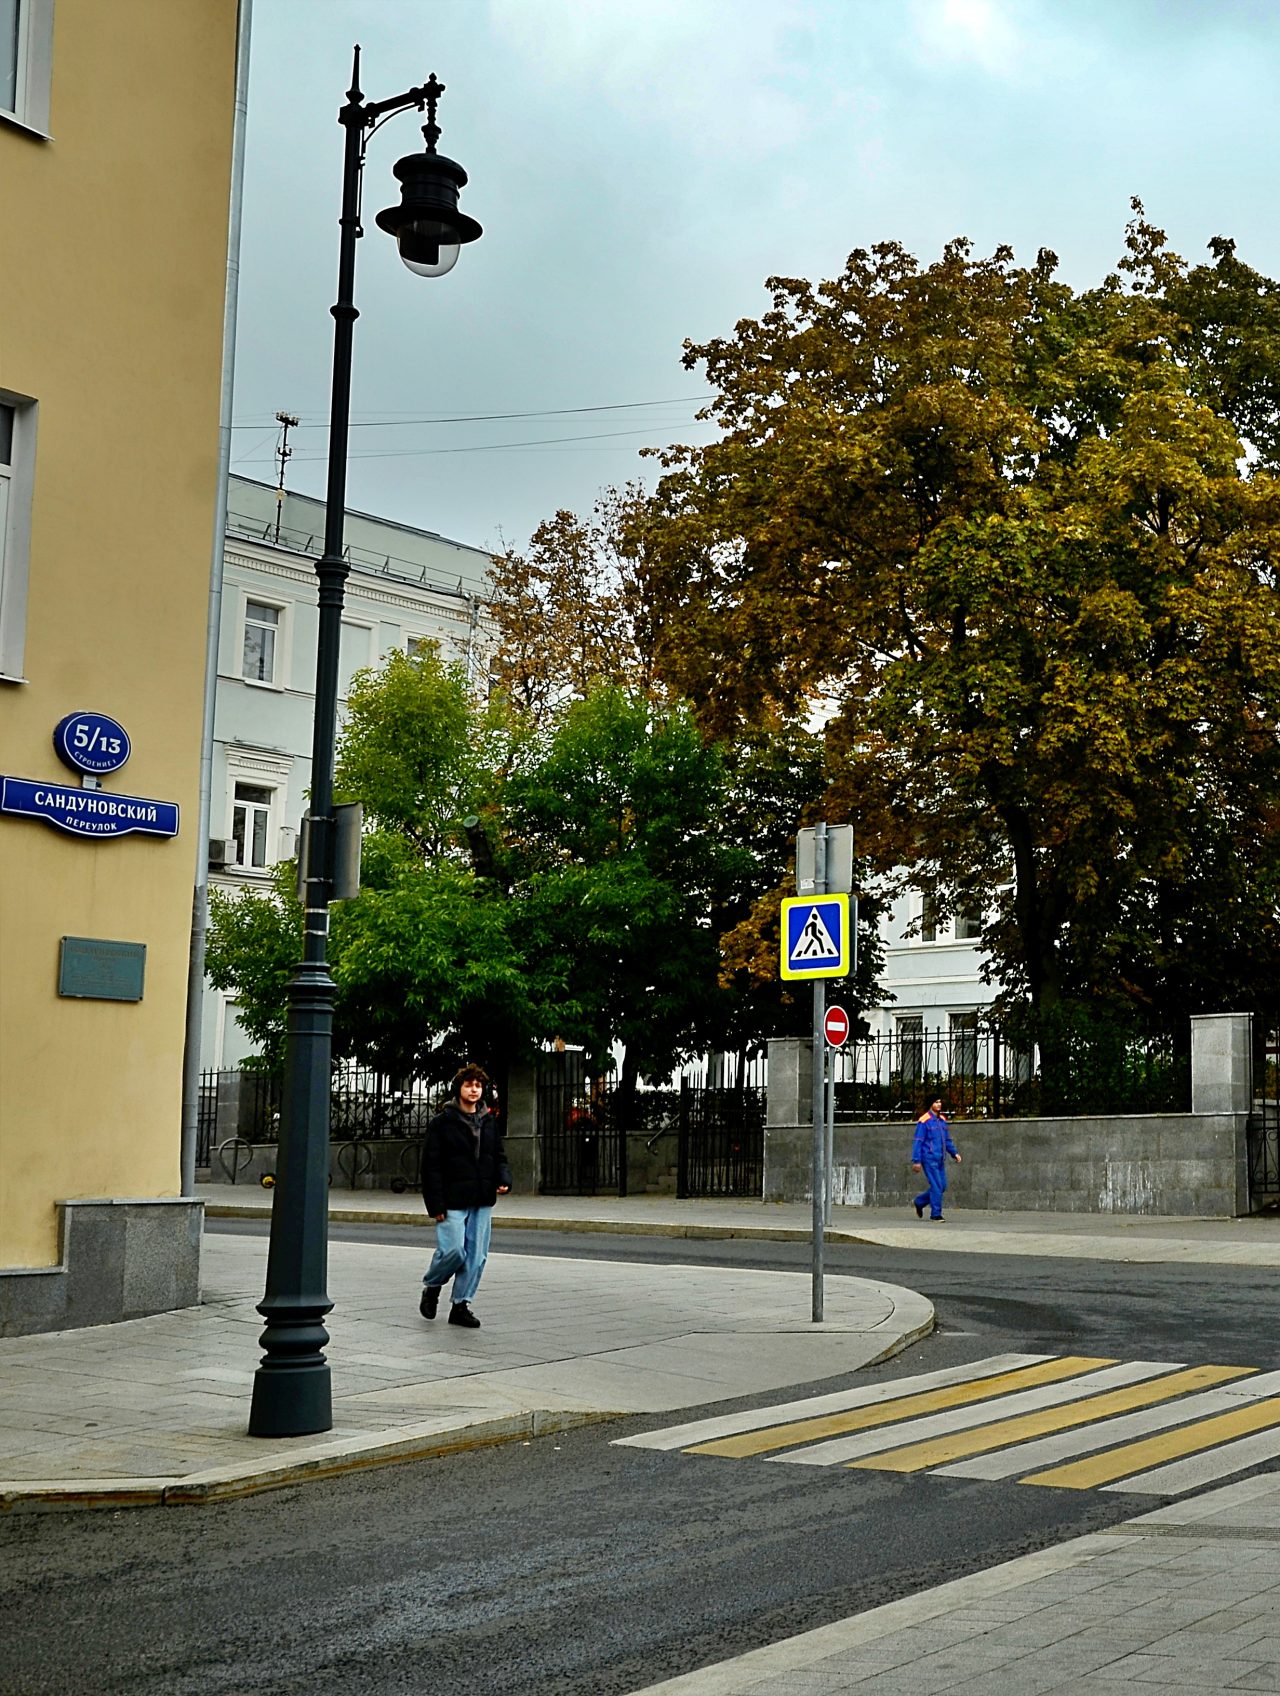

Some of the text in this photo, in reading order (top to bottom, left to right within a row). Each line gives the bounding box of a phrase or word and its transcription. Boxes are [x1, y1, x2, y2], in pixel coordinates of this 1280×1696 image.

[74, 724, 121, 754] 5/13
[74, 751, 111, 768] СТРОЕНИЕ
[34, 791, 157, 822] САНДУНОВСКИЙ
[65, 816, 117, 831] ПЕРЕУЛОК
